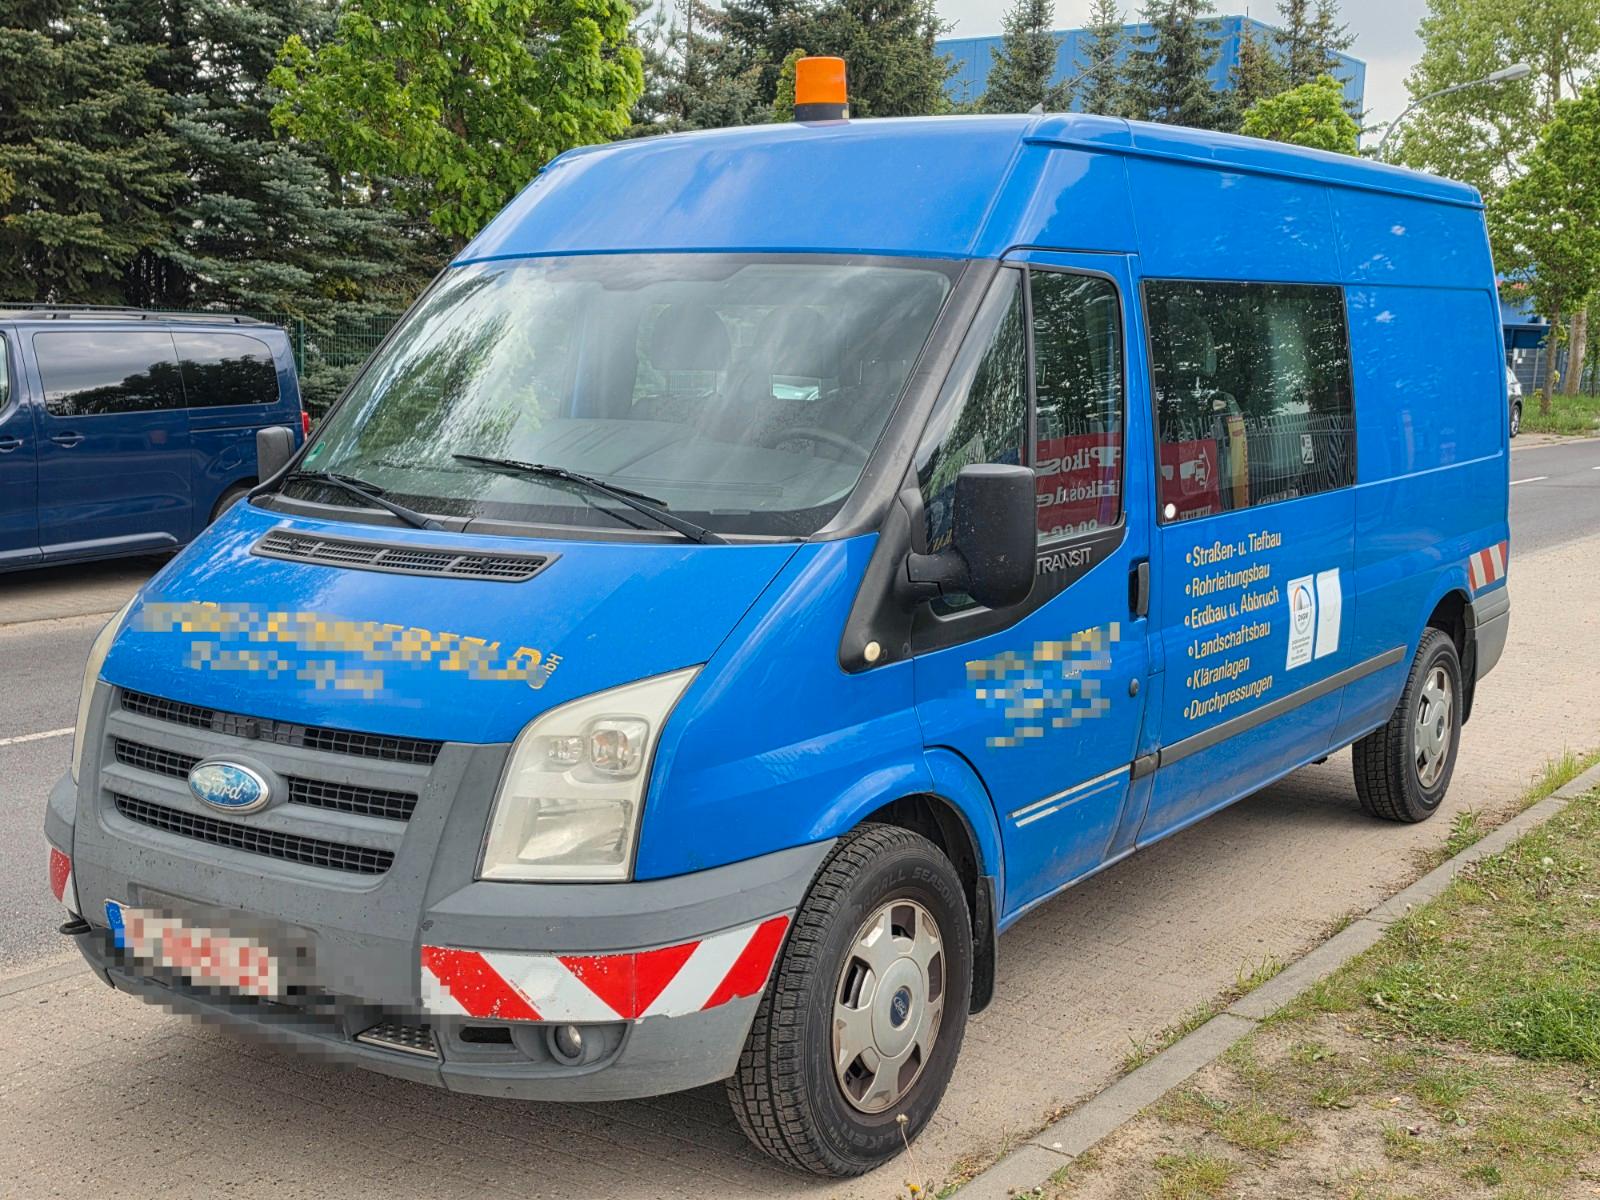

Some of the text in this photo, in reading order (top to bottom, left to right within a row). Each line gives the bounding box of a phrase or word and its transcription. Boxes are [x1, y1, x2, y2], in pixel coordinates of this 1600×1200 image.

[1036, 547, 1092, 576] TRANSIT
[1192, 530, 1282, 568] Straßen- u. Tiefbau
[1192, 562, 1270, 598] Rohrleitungsbau
[1191, 585, 1280, 629] Erdbau u. Abbruch
[1194, 621, 1271, 660] Landschaftsbau
[1193, 656, 1250, 690] Kläranlagen
[1189, 675, 1273, 720] Durchpressungen
[912, 866, 957, 909] SEASON
